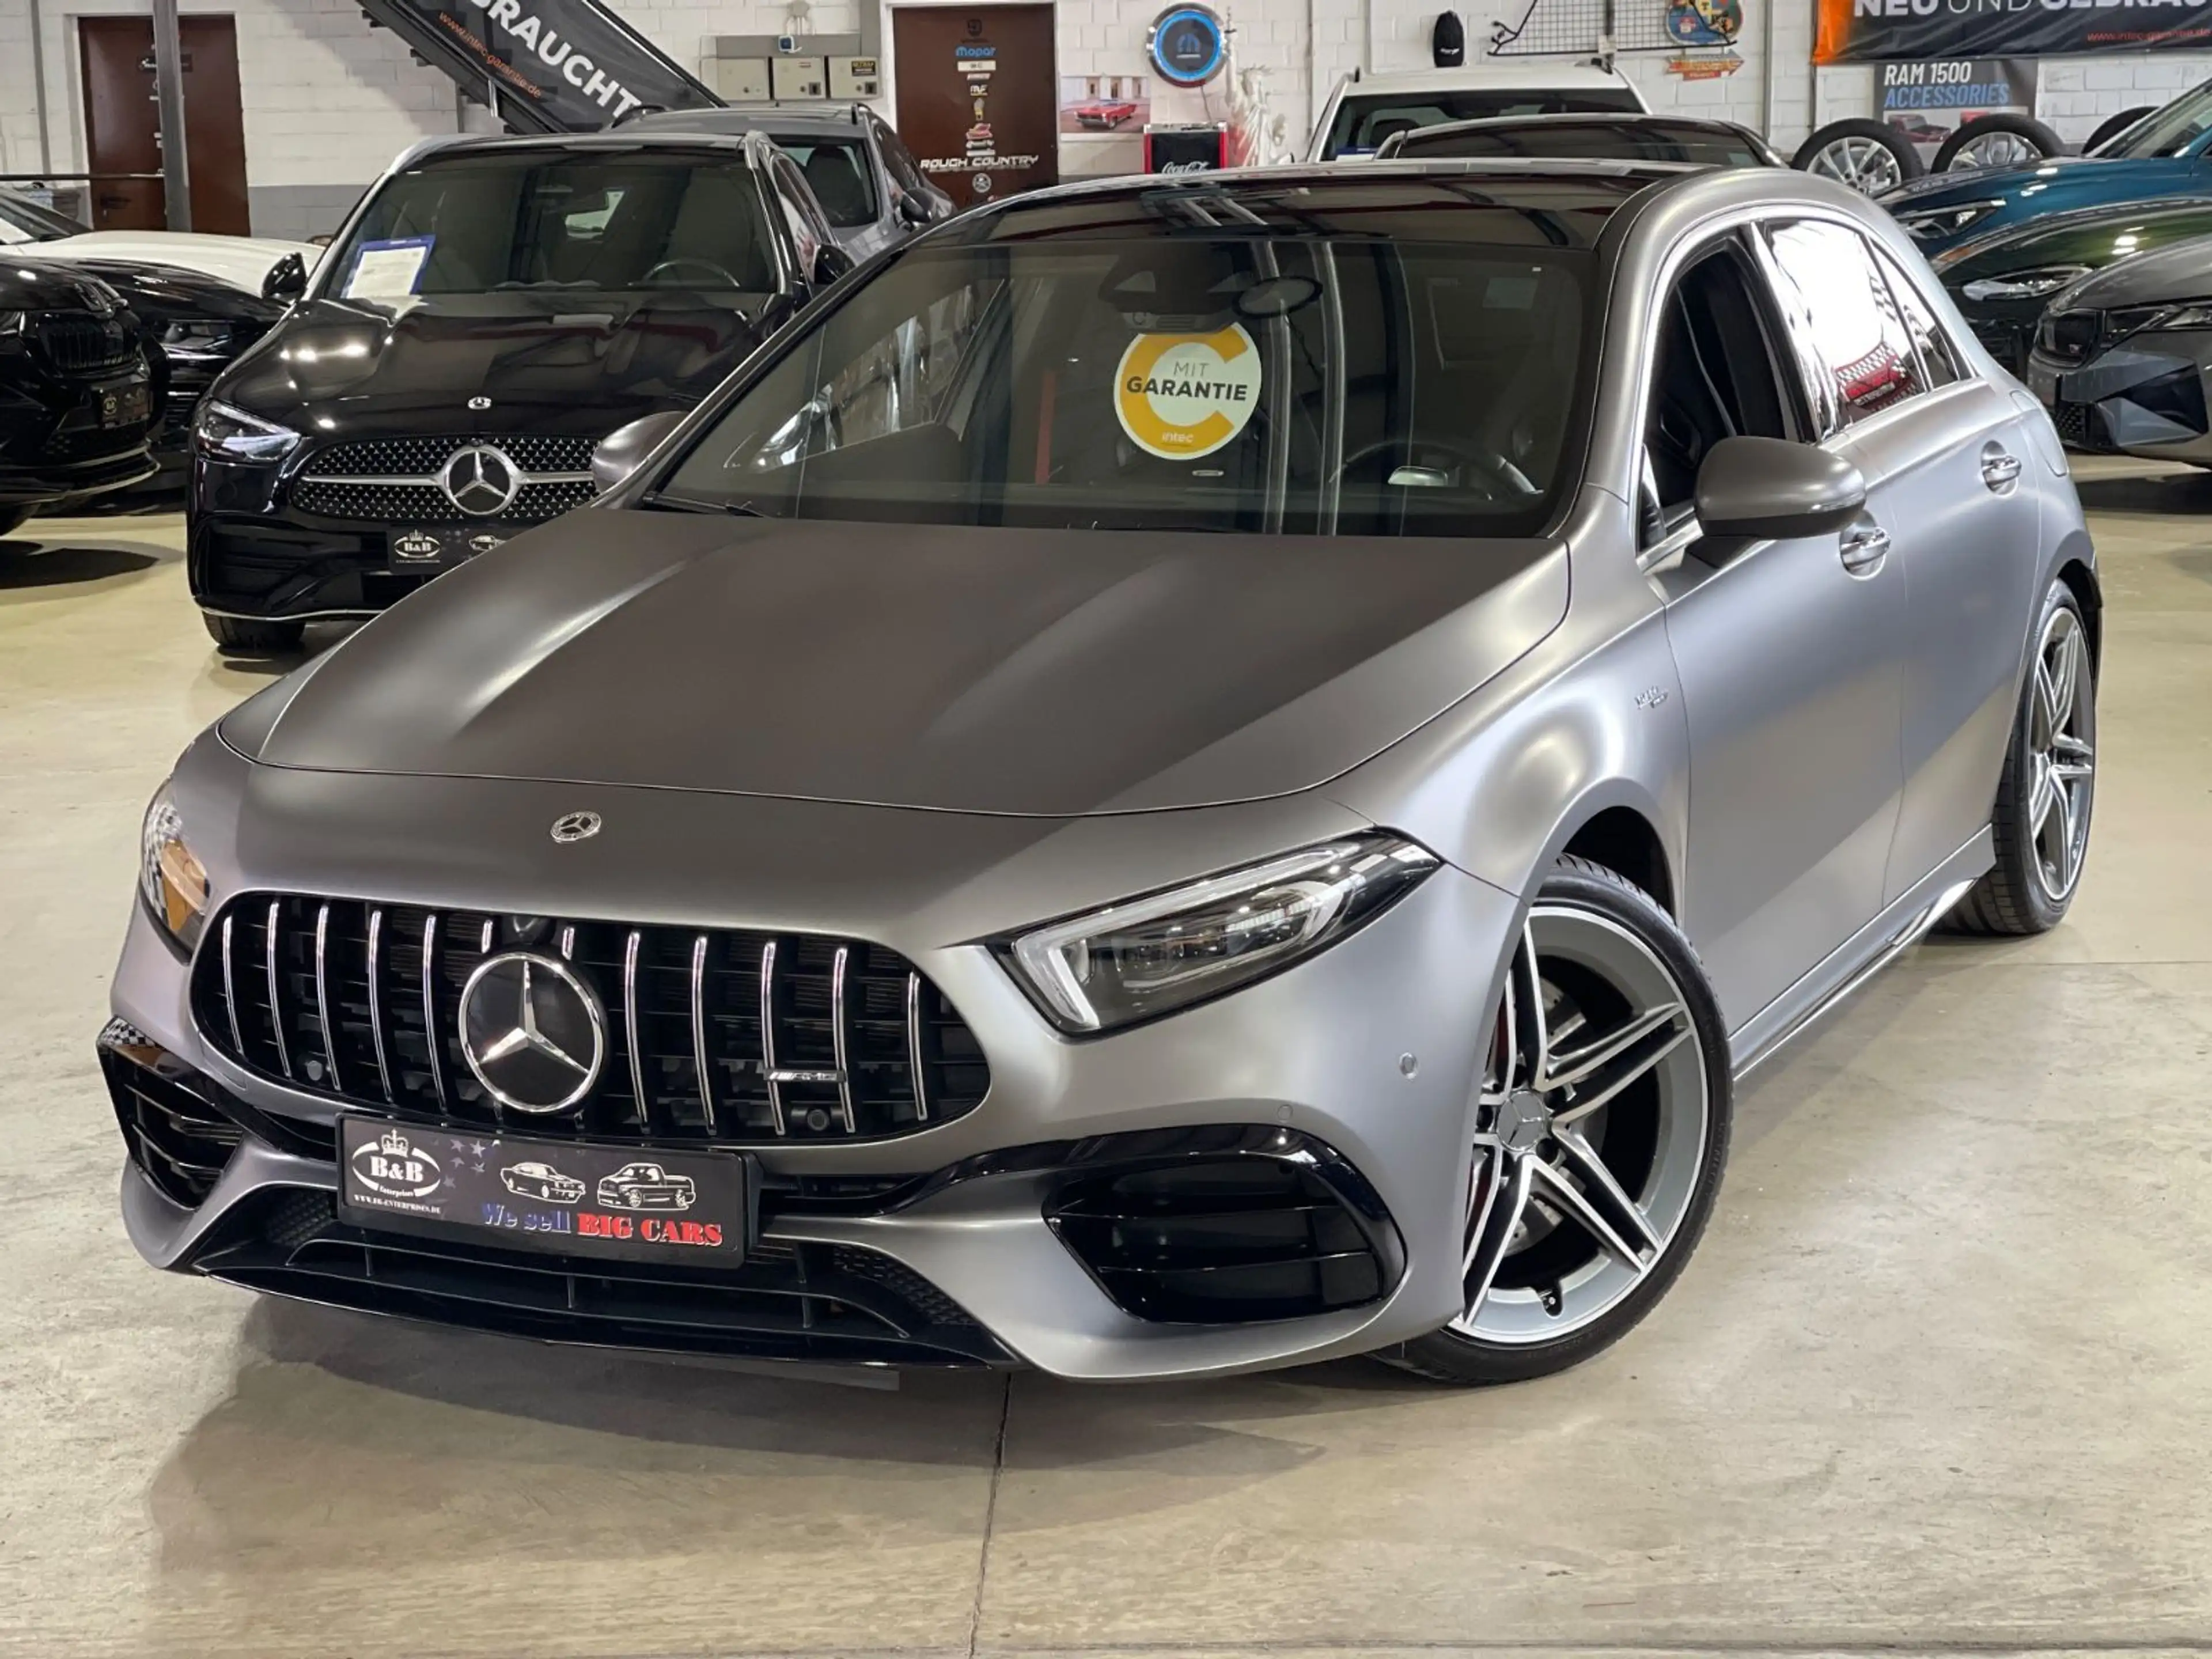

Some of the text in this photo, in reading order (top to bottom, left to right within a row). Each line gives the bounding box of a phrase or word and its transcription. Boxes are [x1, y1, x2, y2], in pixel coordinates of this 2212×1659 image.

[471, 0, 642, 118] RAUCHT
[1884, 61, 1972, 85] RAM 1500
[1884, 83, 2010, 108] ACCESSORIES
[920, 157, 968, 169] ROUGH
[972, 154, 1039, 167] COUNTRY
[1173, 361, 1210, 377] MIT
[1126, 376, 1248, 402] GARANTIE
[369, 1155, 425, 1183] B&B
[482, 1203, 724, 1247] We sell BIG CARS
